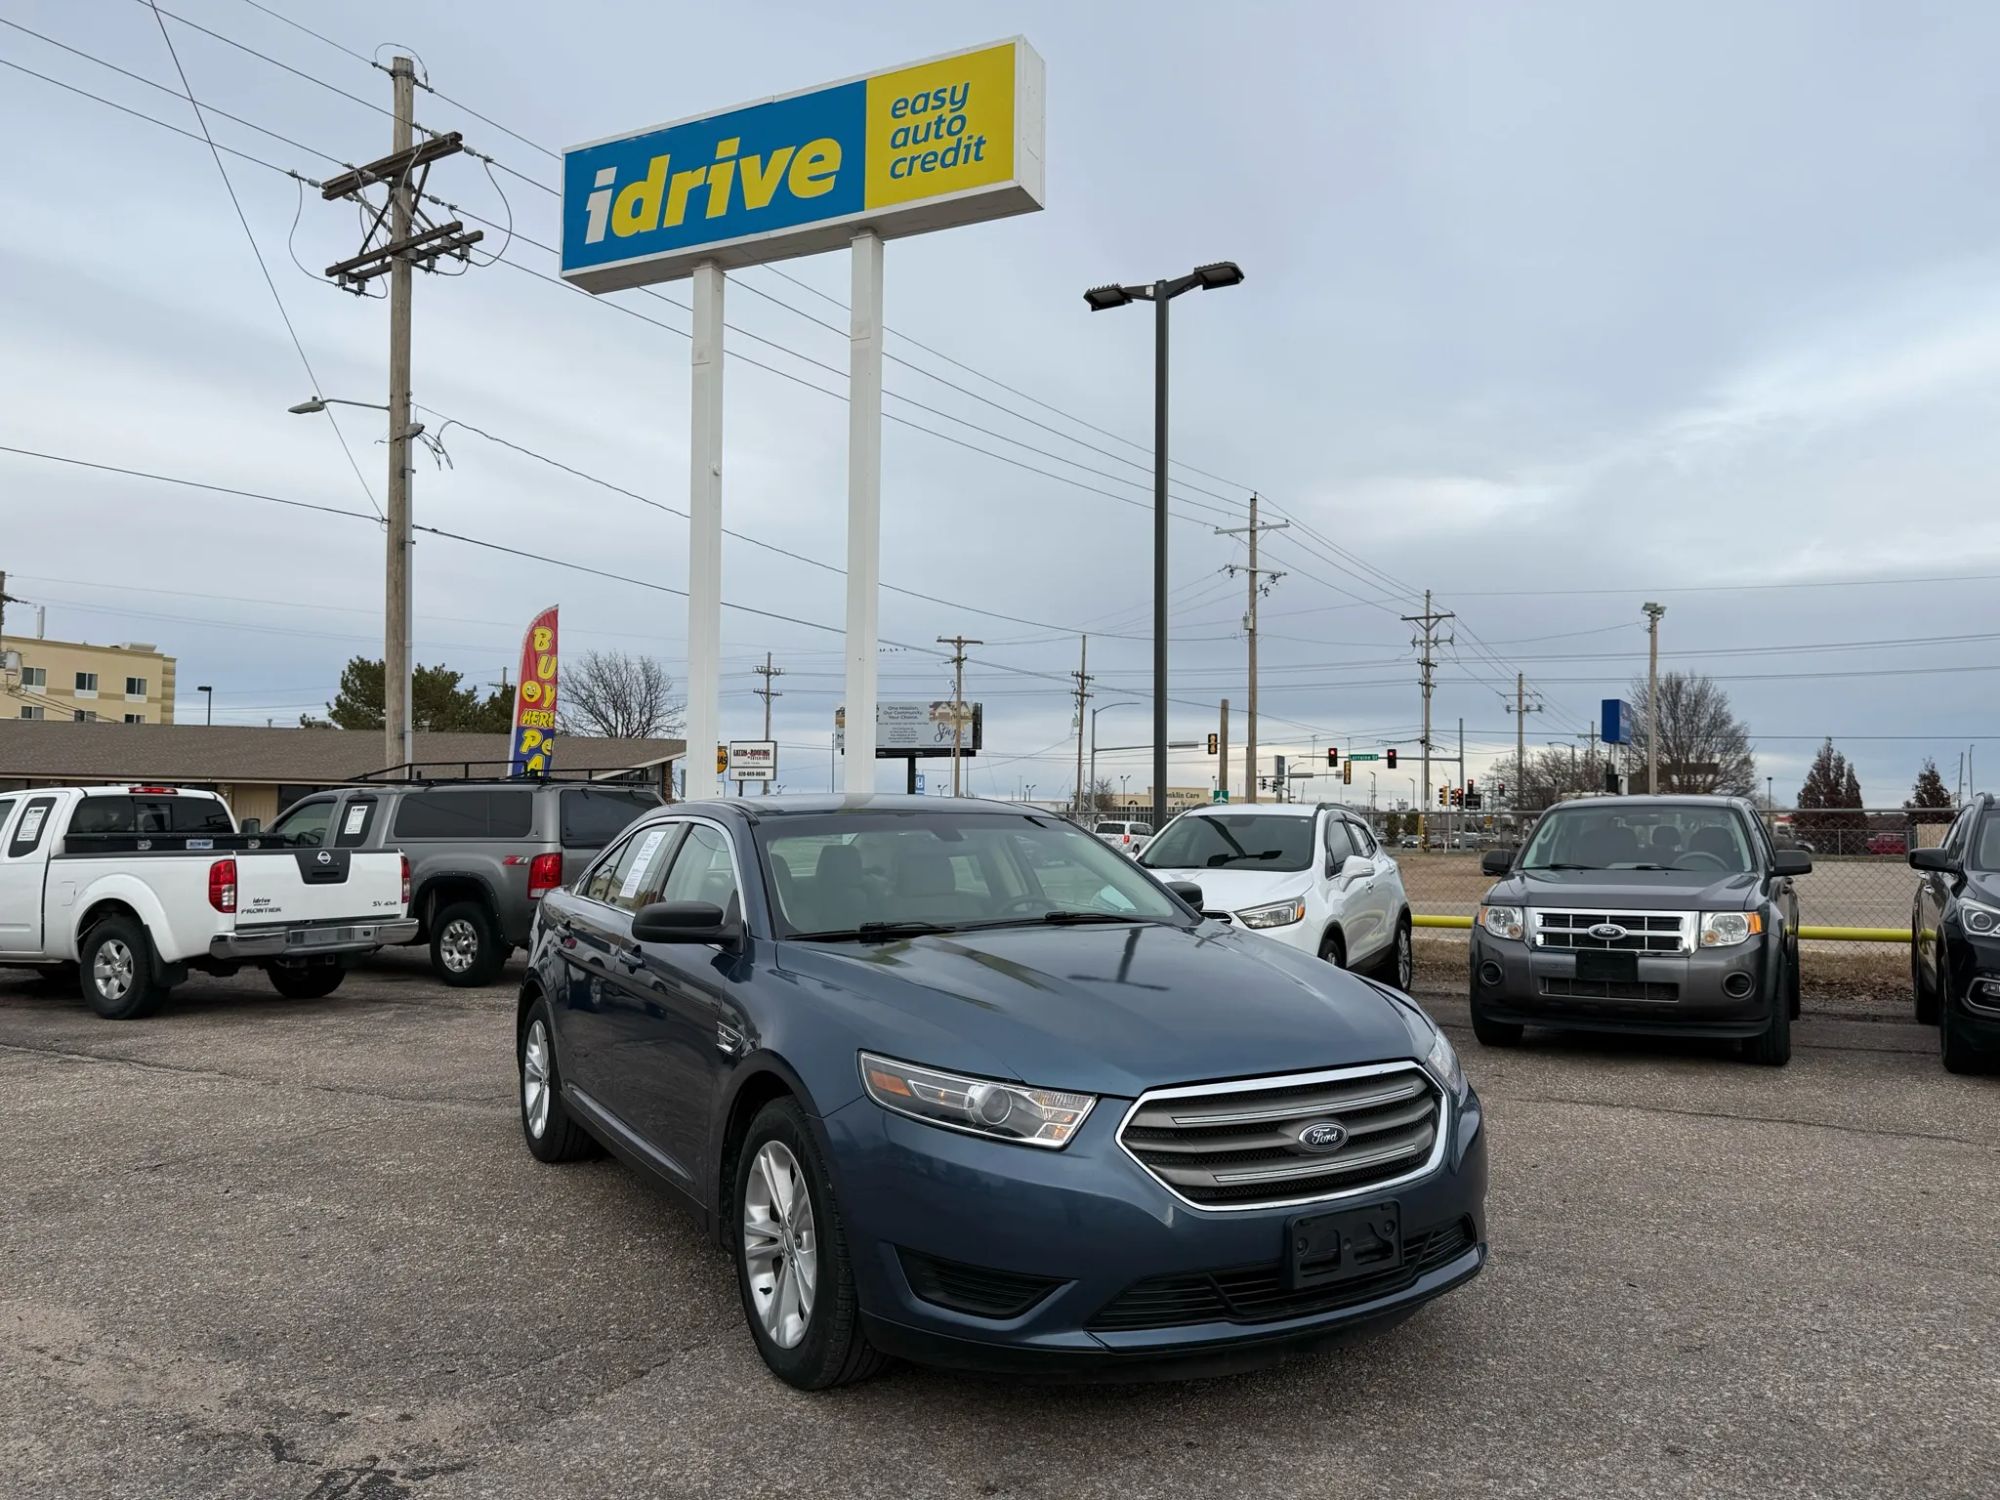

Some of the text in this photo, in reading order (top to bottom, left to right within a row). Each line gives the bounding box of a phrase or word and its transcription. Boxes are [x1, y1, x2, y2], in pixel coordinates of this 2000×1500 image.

[891, 82, 970, 119] easy
[890, 114, 967, 149] auto
[890, 134, 987, 179] credit
[585, 137, 842, 244] idrive
[533, 625, 558, 708] BUY
[1311, 1128, 1339, 1145] Ford
